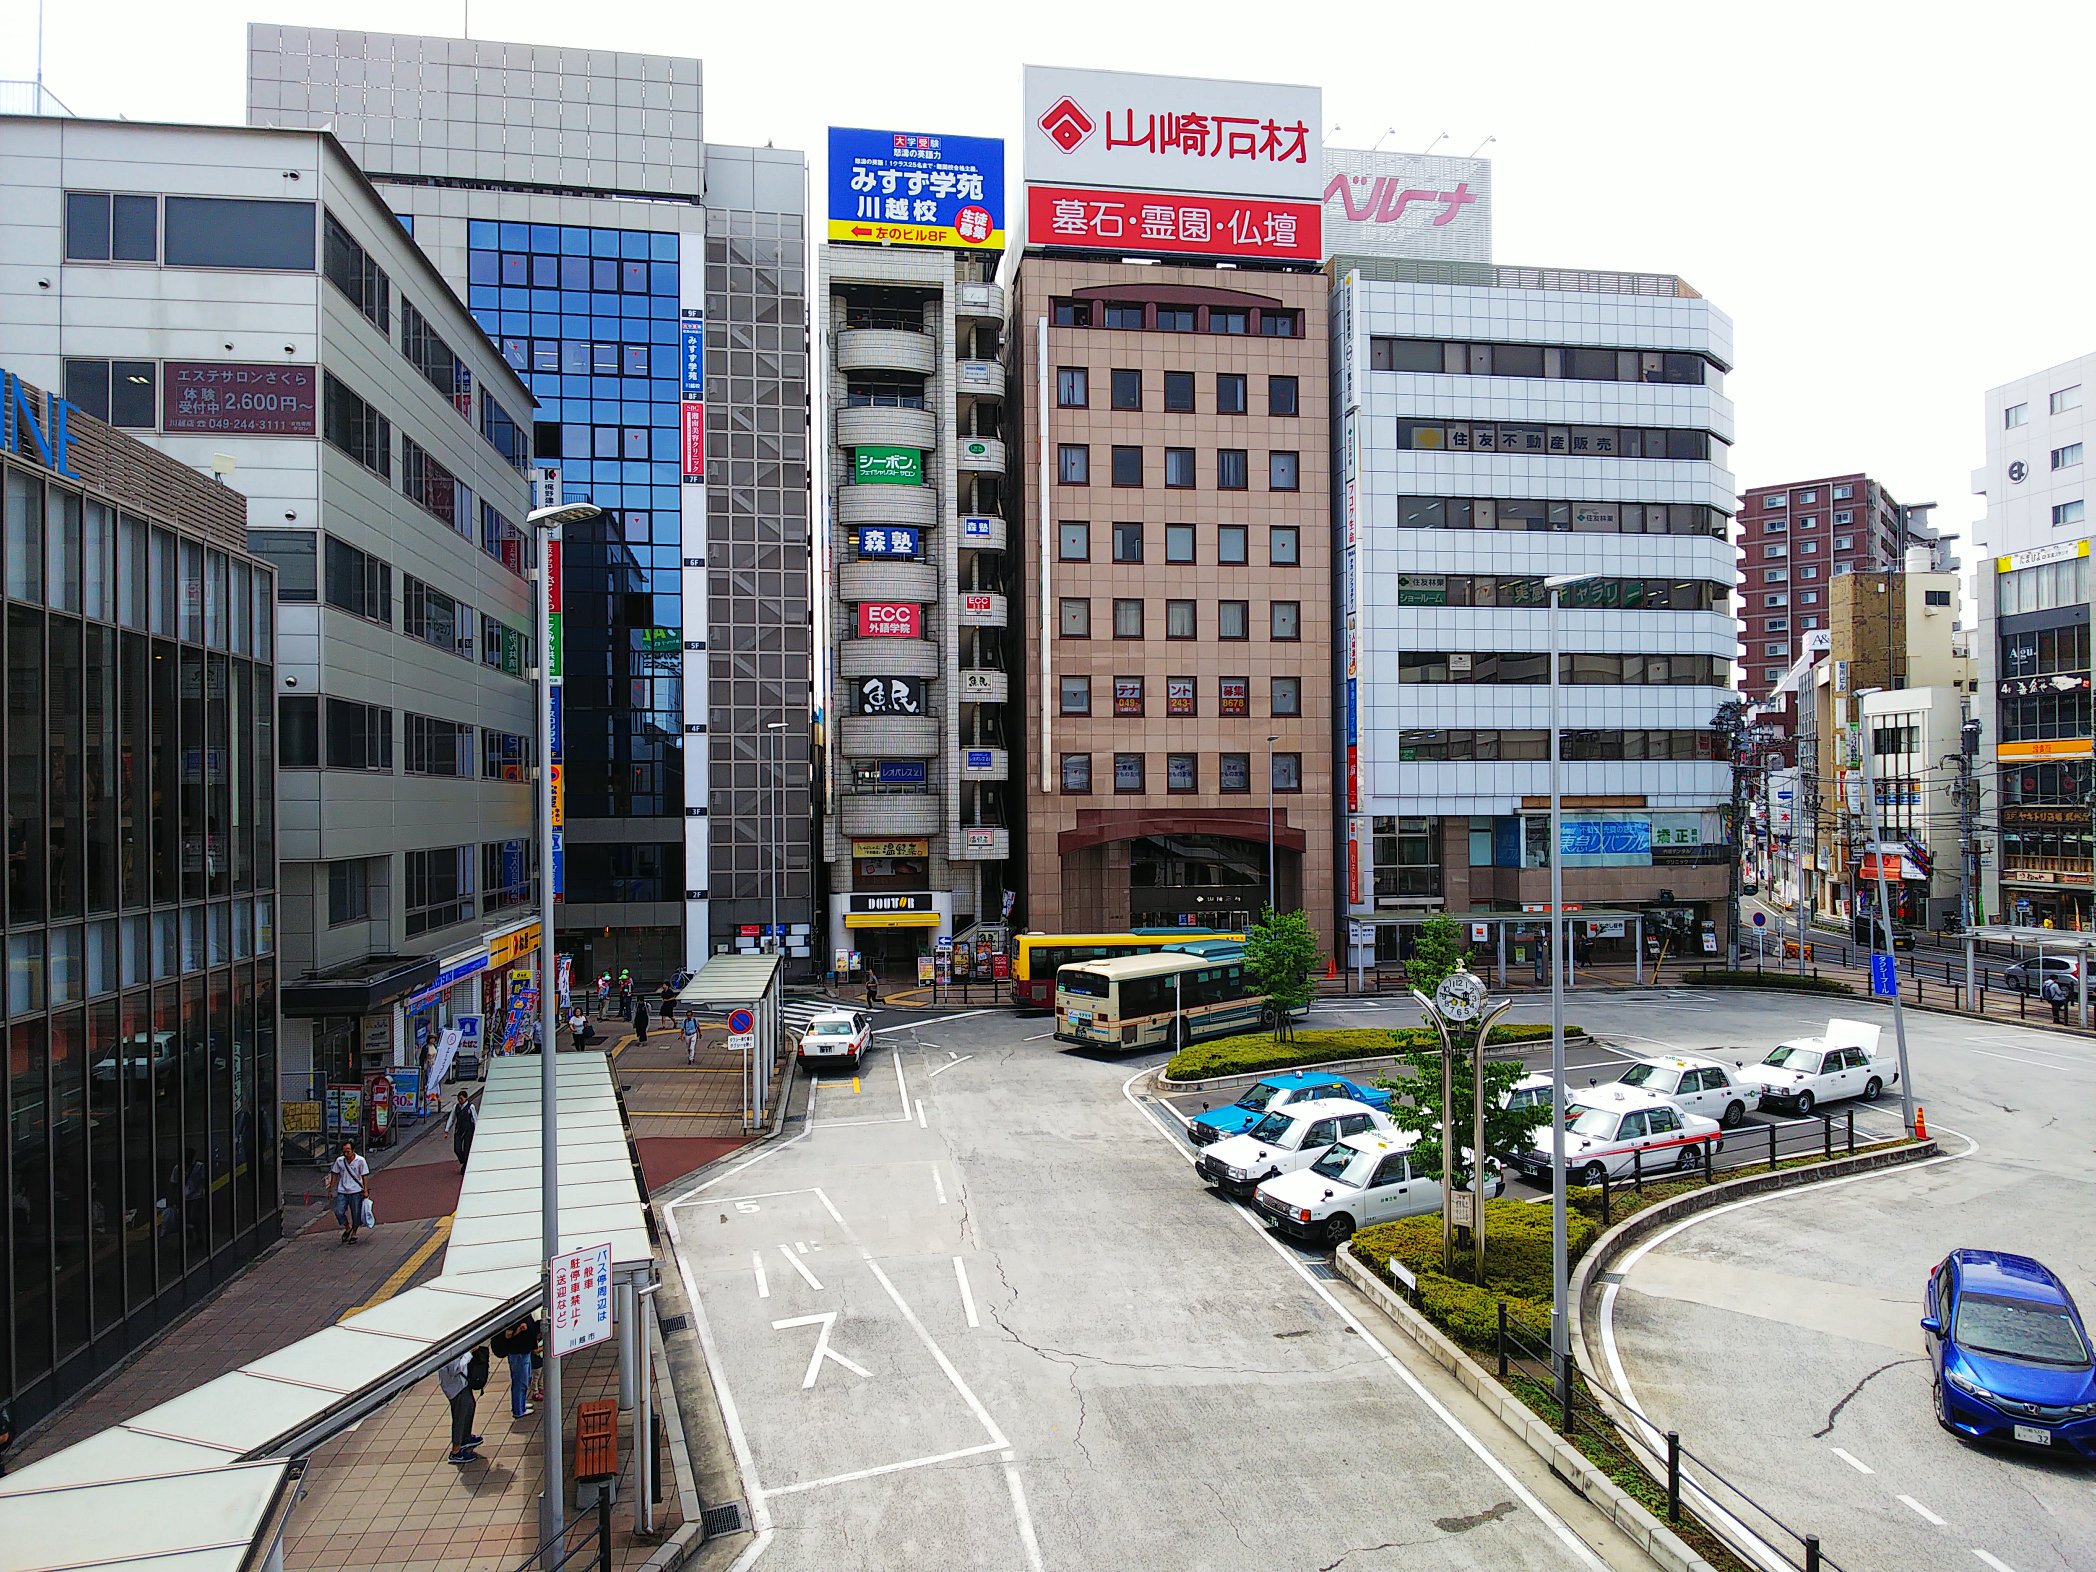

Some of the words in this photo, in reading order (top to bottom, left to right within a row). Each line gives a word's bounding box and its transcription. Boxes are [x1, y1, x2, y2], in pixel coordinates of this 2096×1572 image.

[894, 135, 941, 150] 大学受験
[1105, 108, 1310, 164] 山崎石材
[850, 167, 984, 201] みすず学苑
[857, 196, 938, 223] 川越校
[1052, 198, 1298, 249] 墓石・霊園・仏壇
[875, 227, 948, 242] 左のビル8F
[177, 369, 308, 386] エステサロンさくら
[183, 387, 217, 401] 体験
[688, 392, 697, 400] 8F
[178, 400, 220, 415] 受付中
[169, 418, 195, 429] 川越店
[208, 418, 287, 431] 049-244-3111
[1453, 431, 1612, 451] 住友不動産販売
[967, 521, 989, 533] 森塾
[864, 529, 913, 553] 森塾
[968, 597, 989, 605] ECC
[1399, 593, 1443, 604] ショールーム
[868, 606, 911, 622] ECC
[868, 623, 911, 635] 外語学院
[862, 678, 920, 714] 魚民
[1117, 685, 1140, 697] テナ
[1170, 685, 1192, 697] ント
[1222, 685, 1245, 697] 募集
[1118, 698, 1139, 708] 049-
[1222, 699, 1245, 708] 8678
[882, 767, 923, 777] レオパレス21
[1560, 834, 1651, 853] 東急リバブル
[1656, 828, 1689, 844] 矯正
[691, 891, 702, 899] 2F
[867, 896, 915, 910] DOUTOR
[1878, 956, 1890, 994] タクシープール
[1455, 979, 1463, 987] 12
[1456, 1008, 1462, 1016] 6
[1464, 1007, 1470, 1015] 5
[734, 1200, 761, 1214] 5
[583, 1257, 594, 1290] 一般車
[596, 1250, 608, 1323] バス停周辺は
[569, 1332, 596, 1348] 川越市
